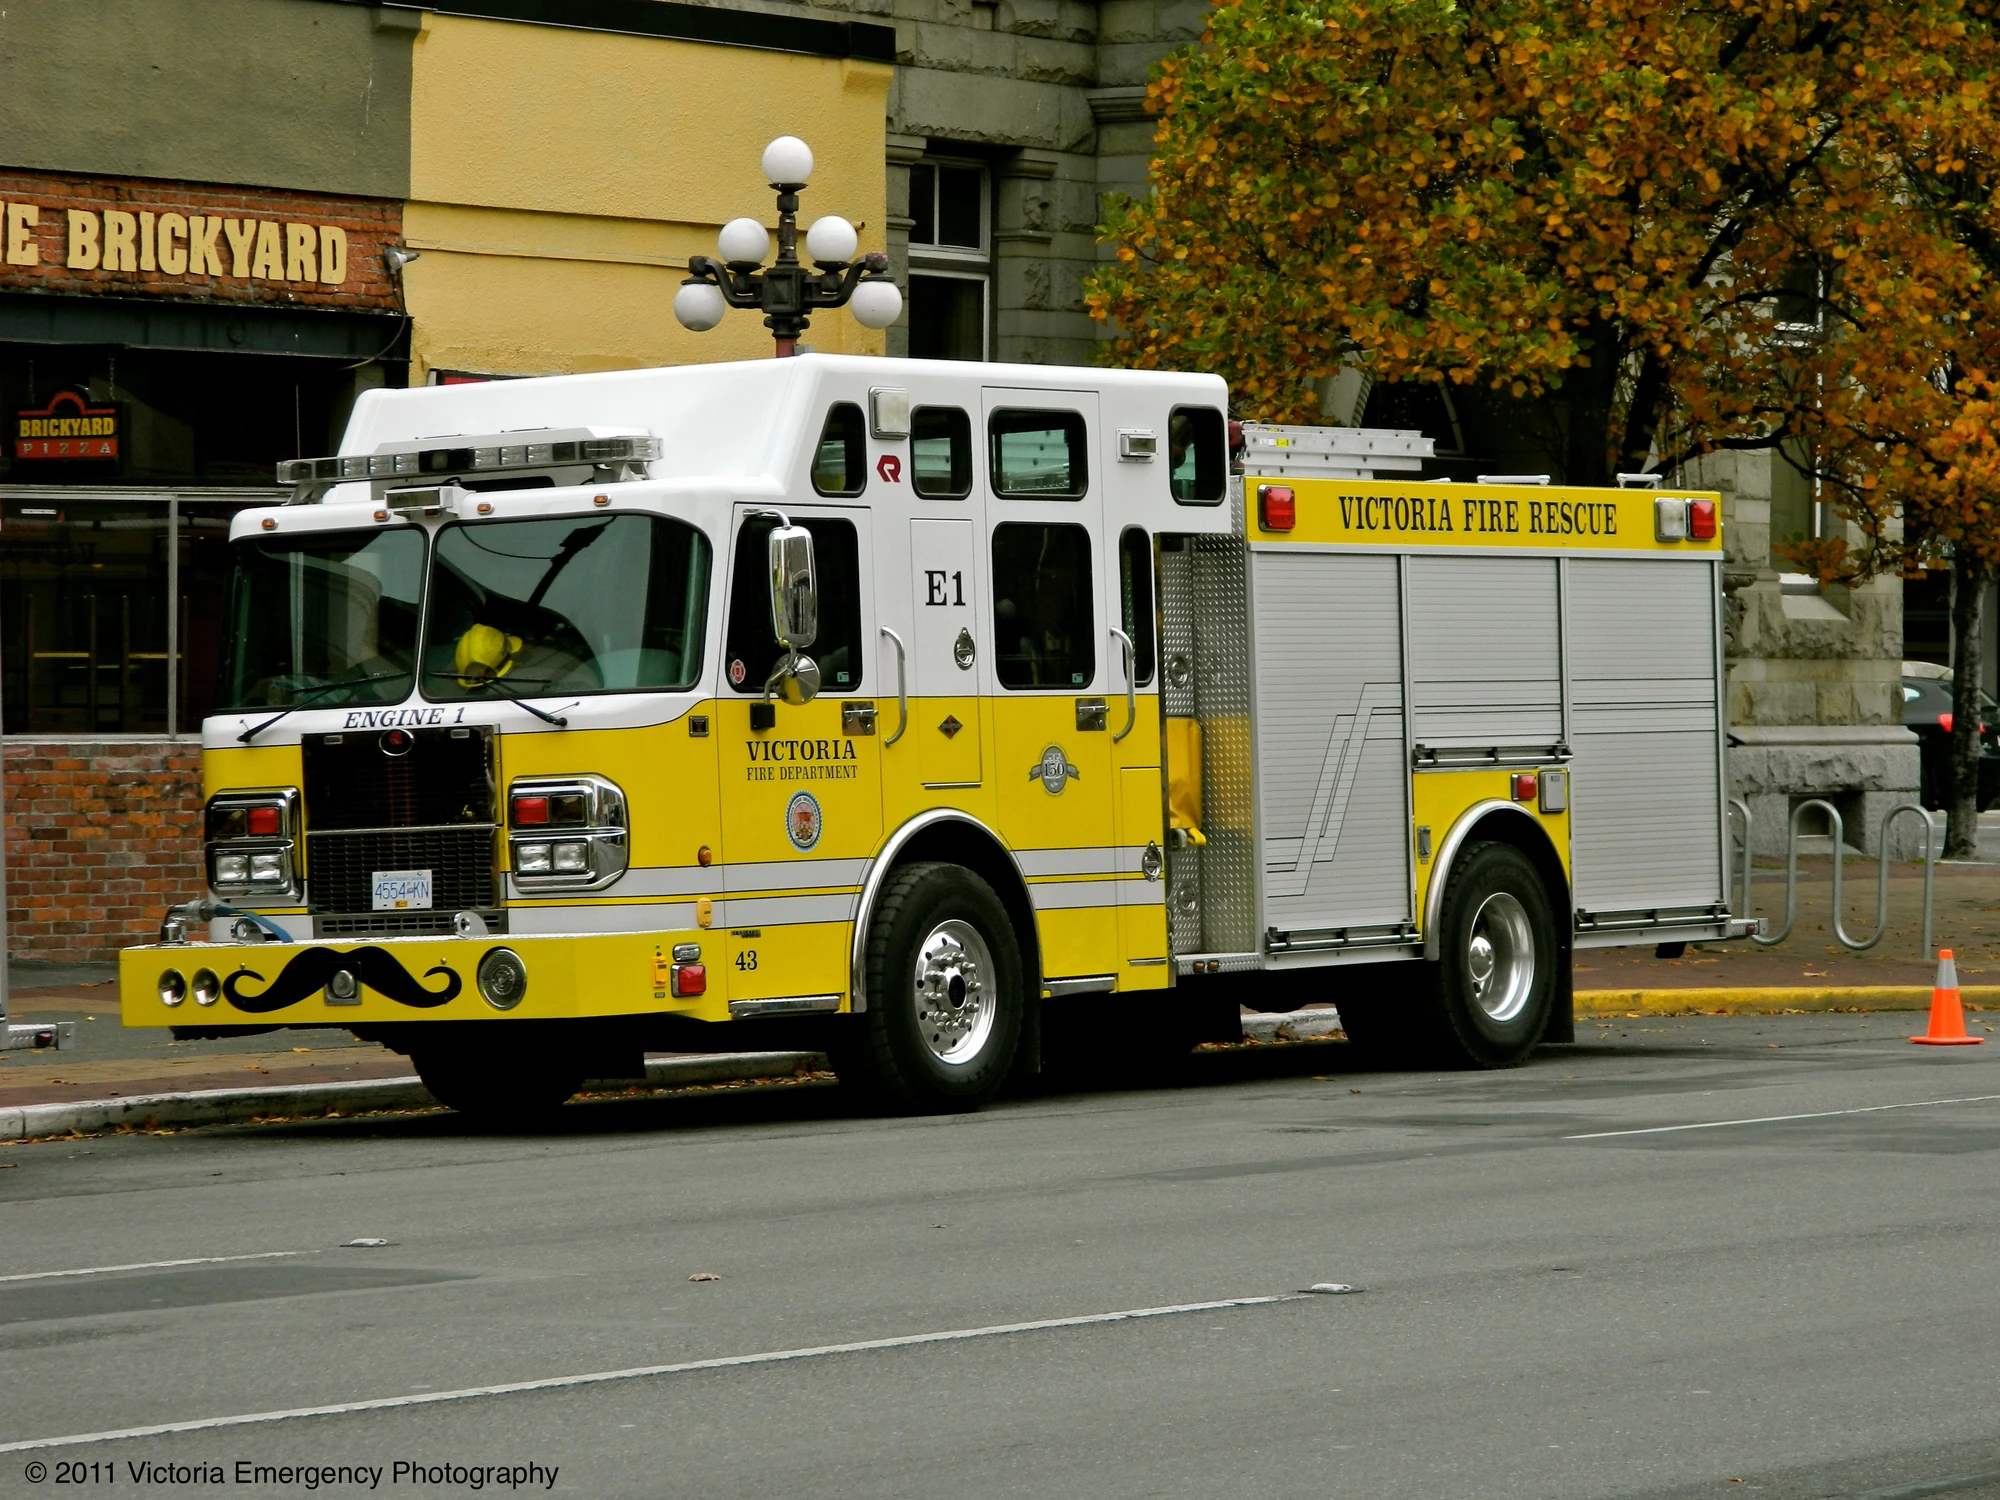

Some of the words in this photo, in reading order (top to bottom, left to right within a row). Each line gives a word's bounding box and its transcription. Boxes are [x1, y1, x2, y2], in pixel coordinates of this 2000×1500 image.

[0, 202, 39, 266] E
[67, 208, 347, 285] BRICKYARD
[20, 417, 114, 437] BRICKYARD
[23, 442, 111, 455] PIZZA
[1338, 495, 1453, 533] VICTORIA
[1462, 500, 1519, 532] FIRE
[1529, 502, 1617, 535] RESCUE
[925, 570, 966, 606] E1
[343, 708, 445, 728] ENGINE
[453, 707, 465, 724] 1
[746, 740, 856, 761] VICTORIA
[747, 767, 775, 781] FIRE
[780, 766, 858, 780] DEPARTMENT
[1044, 763, 1065, 777] 150
[735, 950, 758, 971] 43
